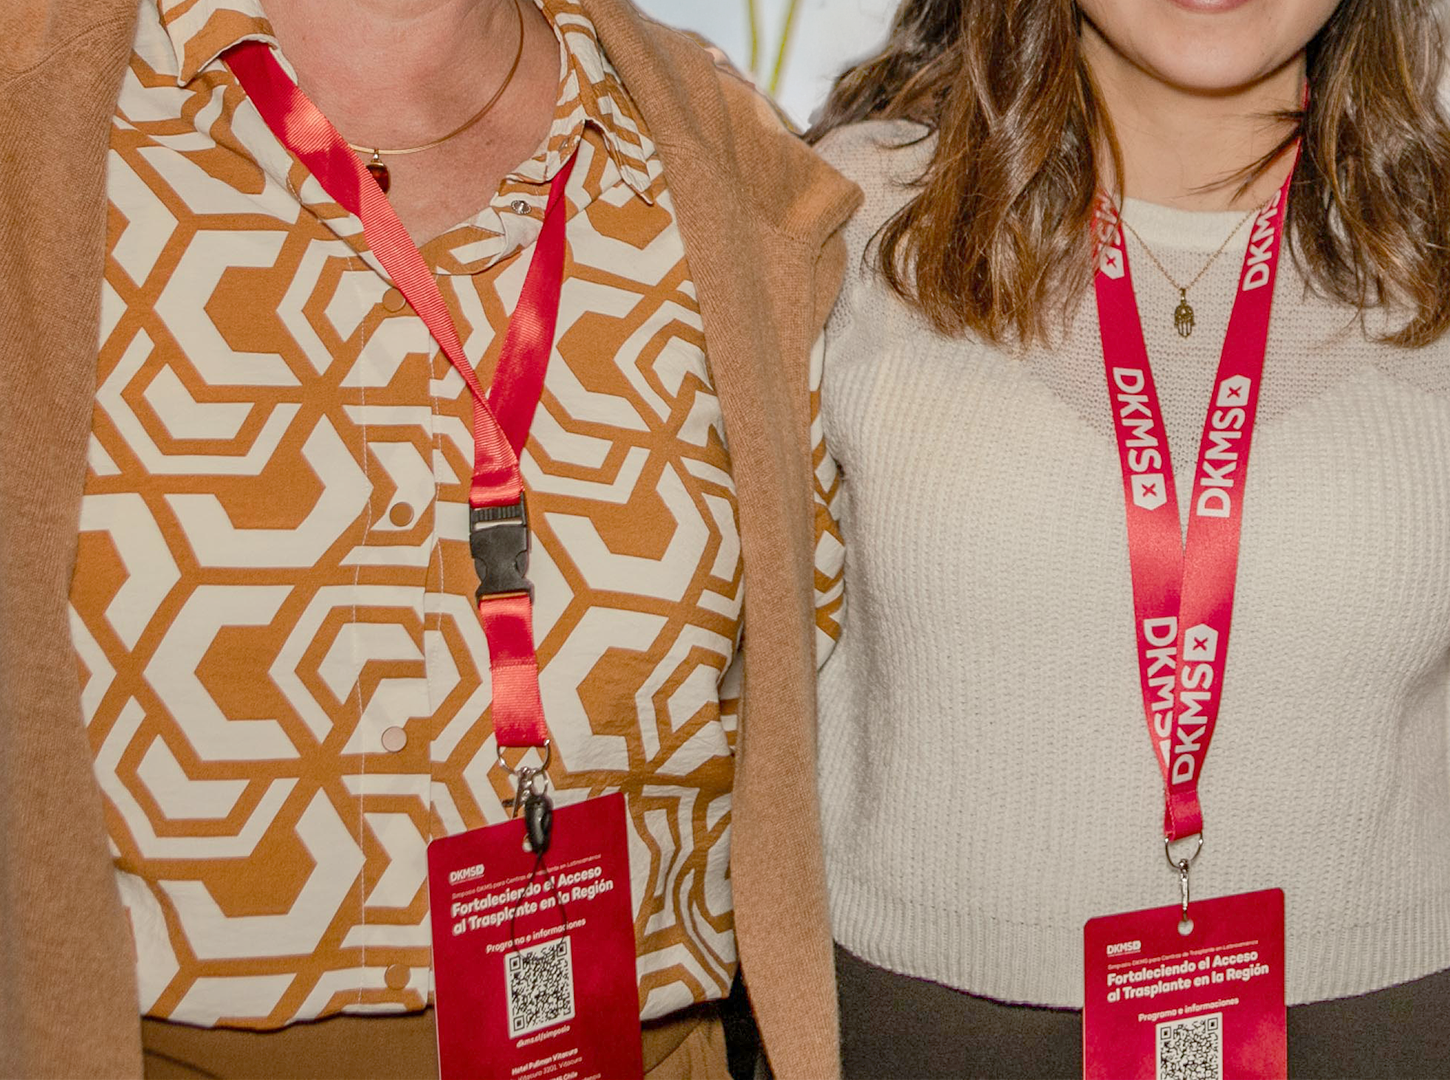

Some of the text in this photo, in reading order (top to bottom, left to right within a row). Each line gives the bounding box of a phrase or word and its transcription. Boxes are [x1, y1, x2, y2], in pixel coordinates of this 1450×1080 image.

[1113, 367, 1162, 472] DKMS
[1197, 407, 1245, 518] DKMS
[1144, 617, 1178, 738] DKMS
[1172, 663, 1214, 785] DKMS
[449, 867, 478, 881] DKMS
[451, 882, 541, 917] Fortaleciendo
[557, 866, 602, 888] Acceso
[453, 919, 466, 936] al
[468, 901, 537, 931] Trasplante
[539, 896, 555, 910] en
[572, 879, 613, 901] Región
[1106, 941, 1134, 955] DKMS
[1107, 951, 1258, 986] Fortaleciendo el Acceso
[1107, 964, 1269, 1003] al Trasplante en la Región
[1138, 997, 1239, 1022] Programa e informaciones
